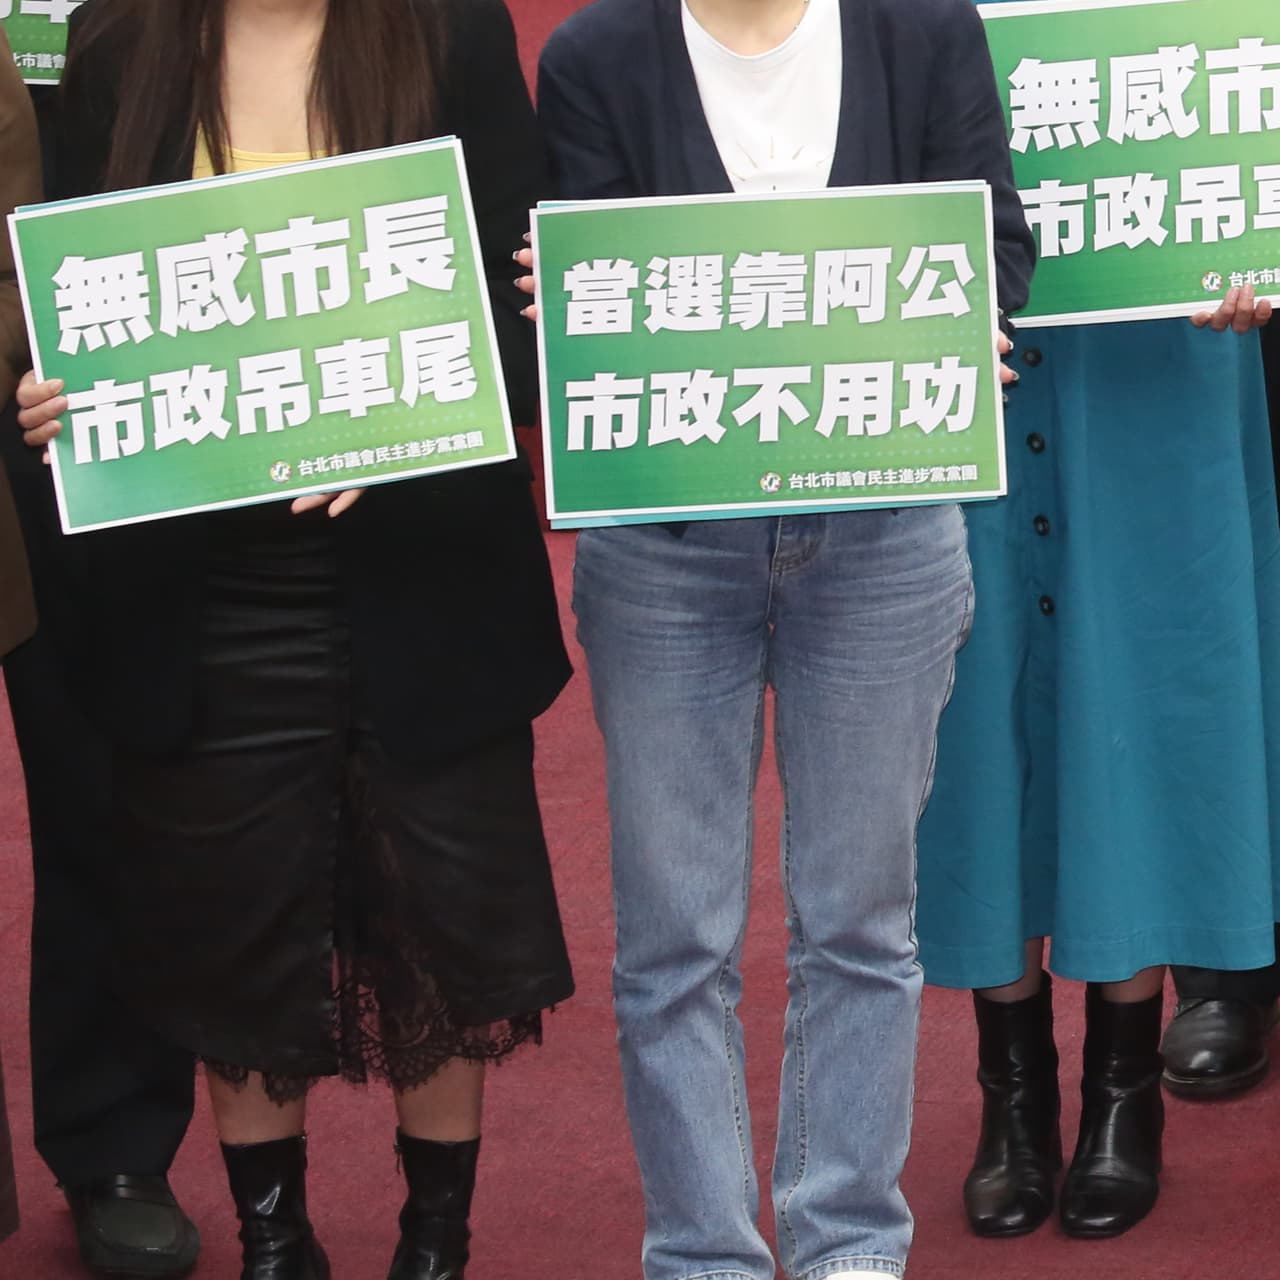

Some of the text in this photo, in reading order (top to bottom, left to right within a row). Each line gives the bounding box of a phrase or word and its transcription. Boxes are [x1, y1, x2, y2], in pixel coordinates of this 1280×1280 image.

[52, 195, 457, 355] 無感市長
[563, 243, 976, 336] 當選靠阿公
[68, 323, 478, 465] 市政吊車尾
[565, 355, 978, 451] 市政不用功
[298, 431, 483, 475] 台北市議會民主進步黨黨團
[789, 464, 978, 488] 台北市議會民主進步黨黨團
